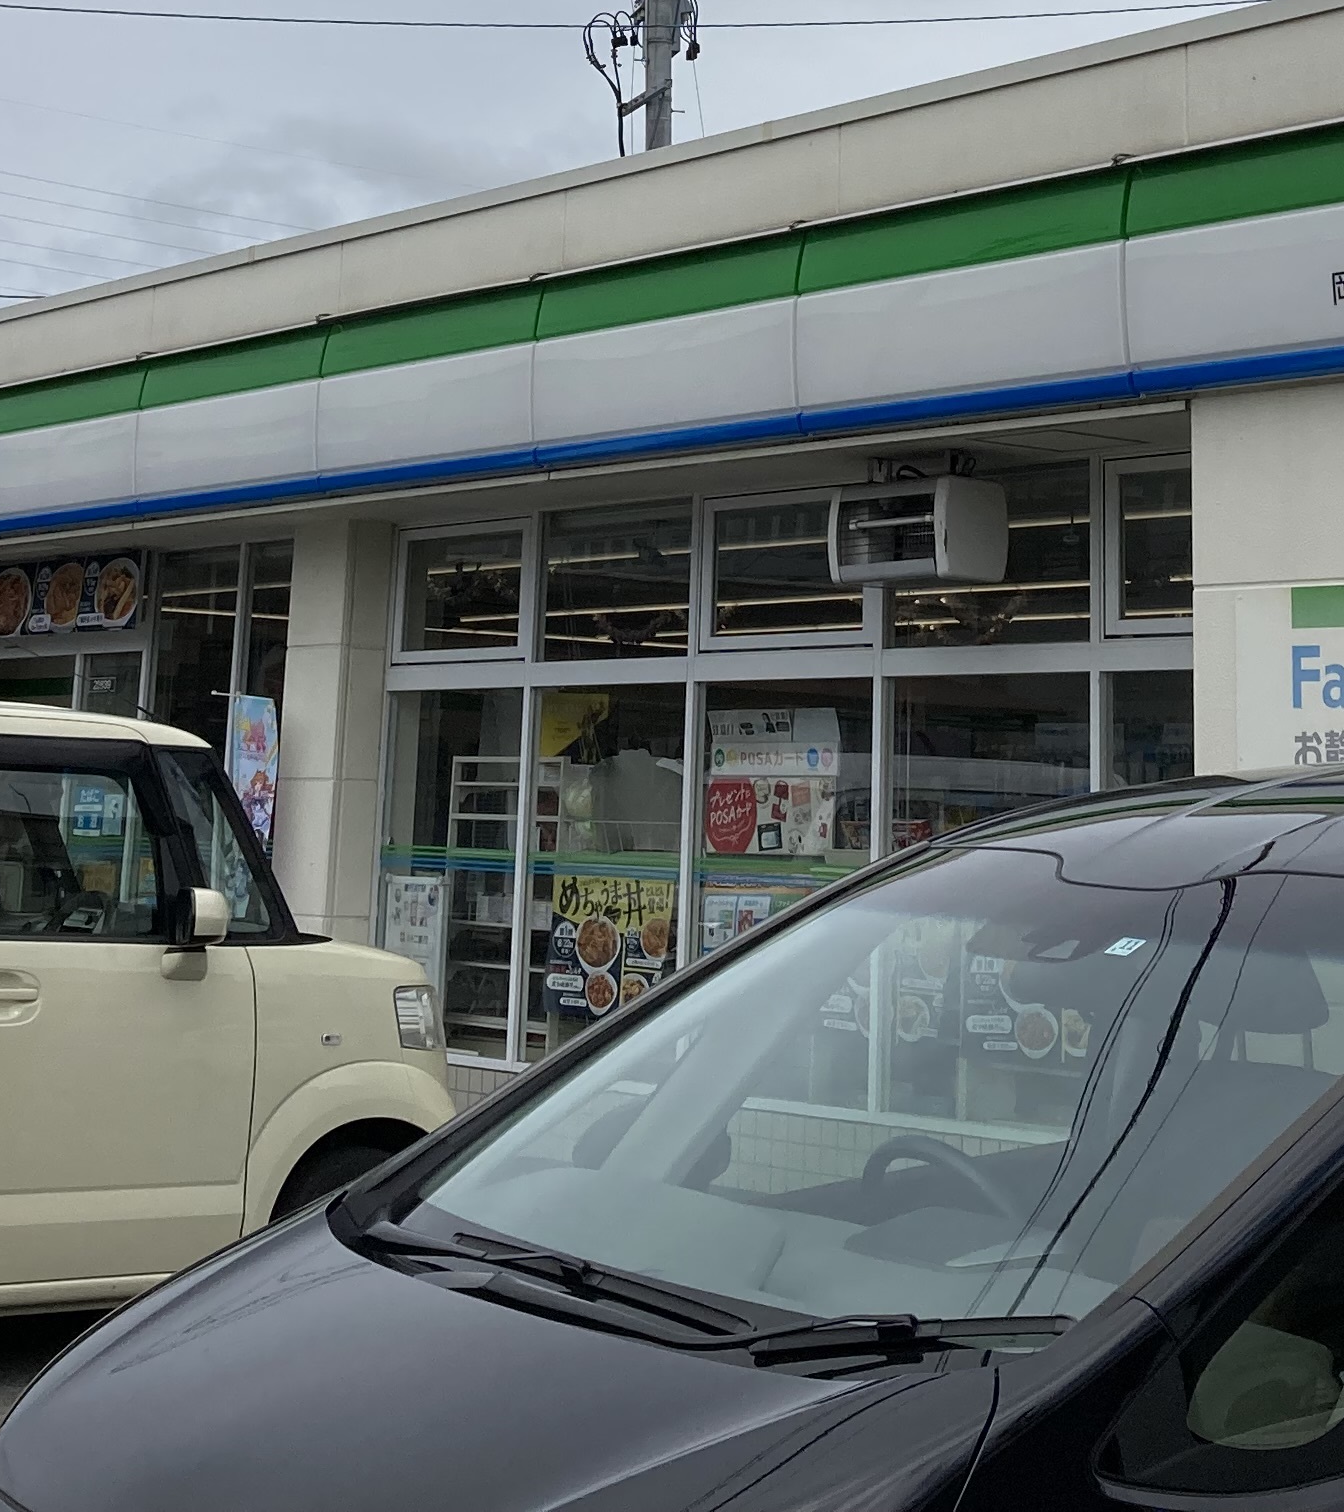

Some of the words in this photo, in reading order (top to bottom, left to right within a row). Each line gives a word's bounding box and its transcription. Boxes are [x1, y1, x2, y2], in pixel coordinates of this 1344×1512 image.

[740, 750, 804, 767] POSAカード
[559, 876, 647, 928] めちゃうま丼
